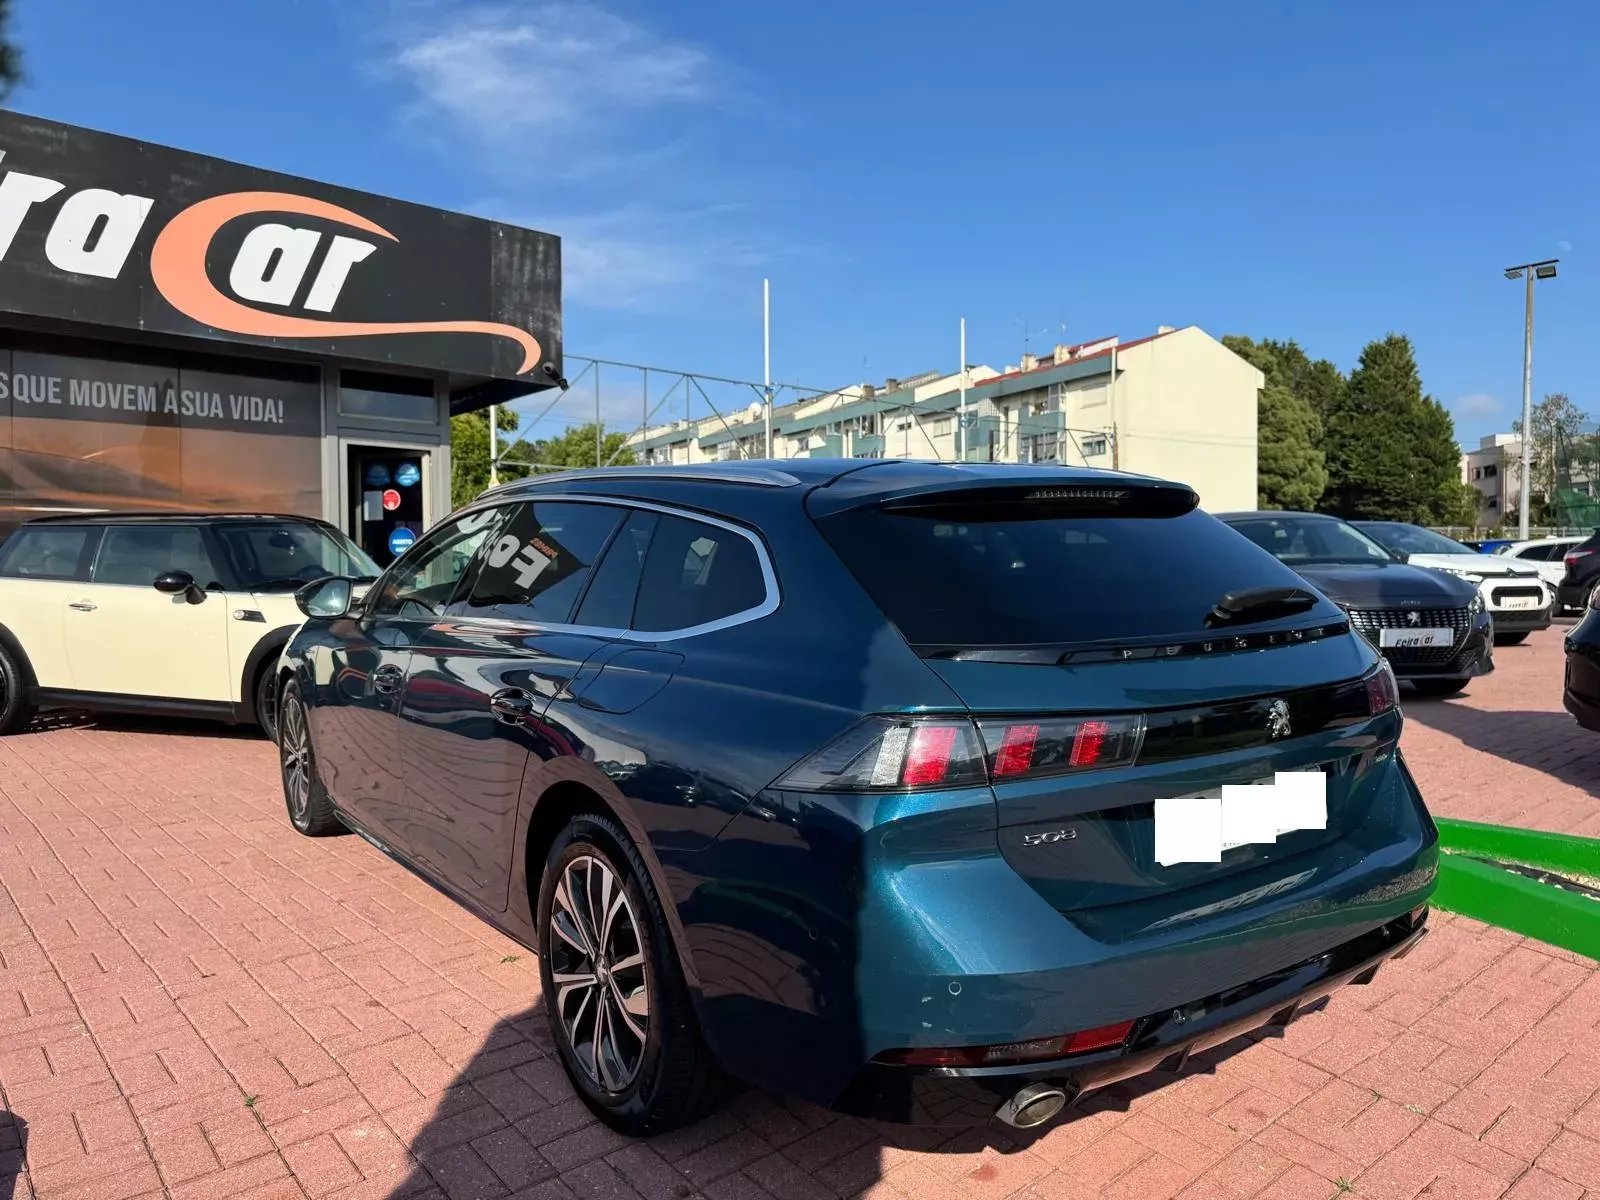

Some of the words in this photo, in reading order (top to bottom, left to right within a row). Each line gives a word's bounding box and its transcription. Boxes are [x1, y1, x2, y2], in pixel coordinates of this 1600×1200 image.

[13, 373, 62, 404] QUE
[69, 378, 156, 412] MOVEM
[229, 394, 284, 424] VIDA!
[1023, 829, 1077, 847] 508
